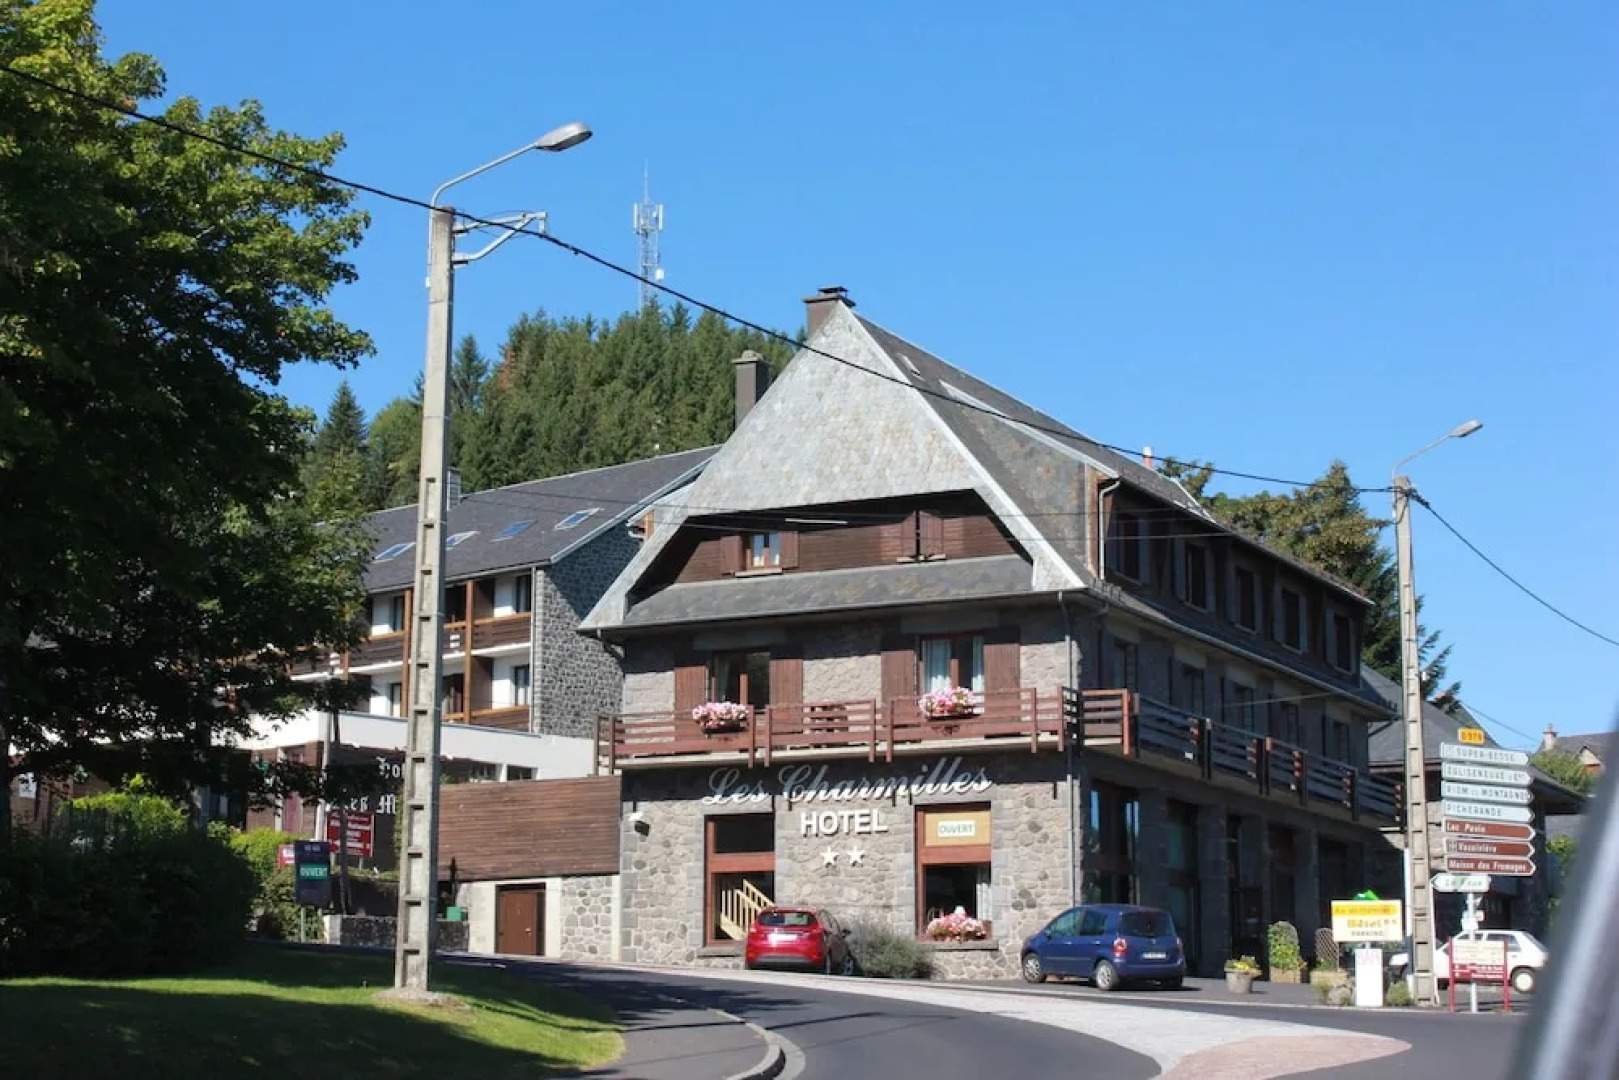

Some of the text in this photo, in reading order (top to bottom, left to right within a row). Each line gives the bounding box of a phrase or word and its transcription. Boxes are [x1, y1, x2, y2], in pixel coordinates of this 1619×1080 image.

[701, 757, 994, 805] Les Charmilles
[800, 808, 888, 836] HOTEL
[938, 823, 972, 834] OUVERT
